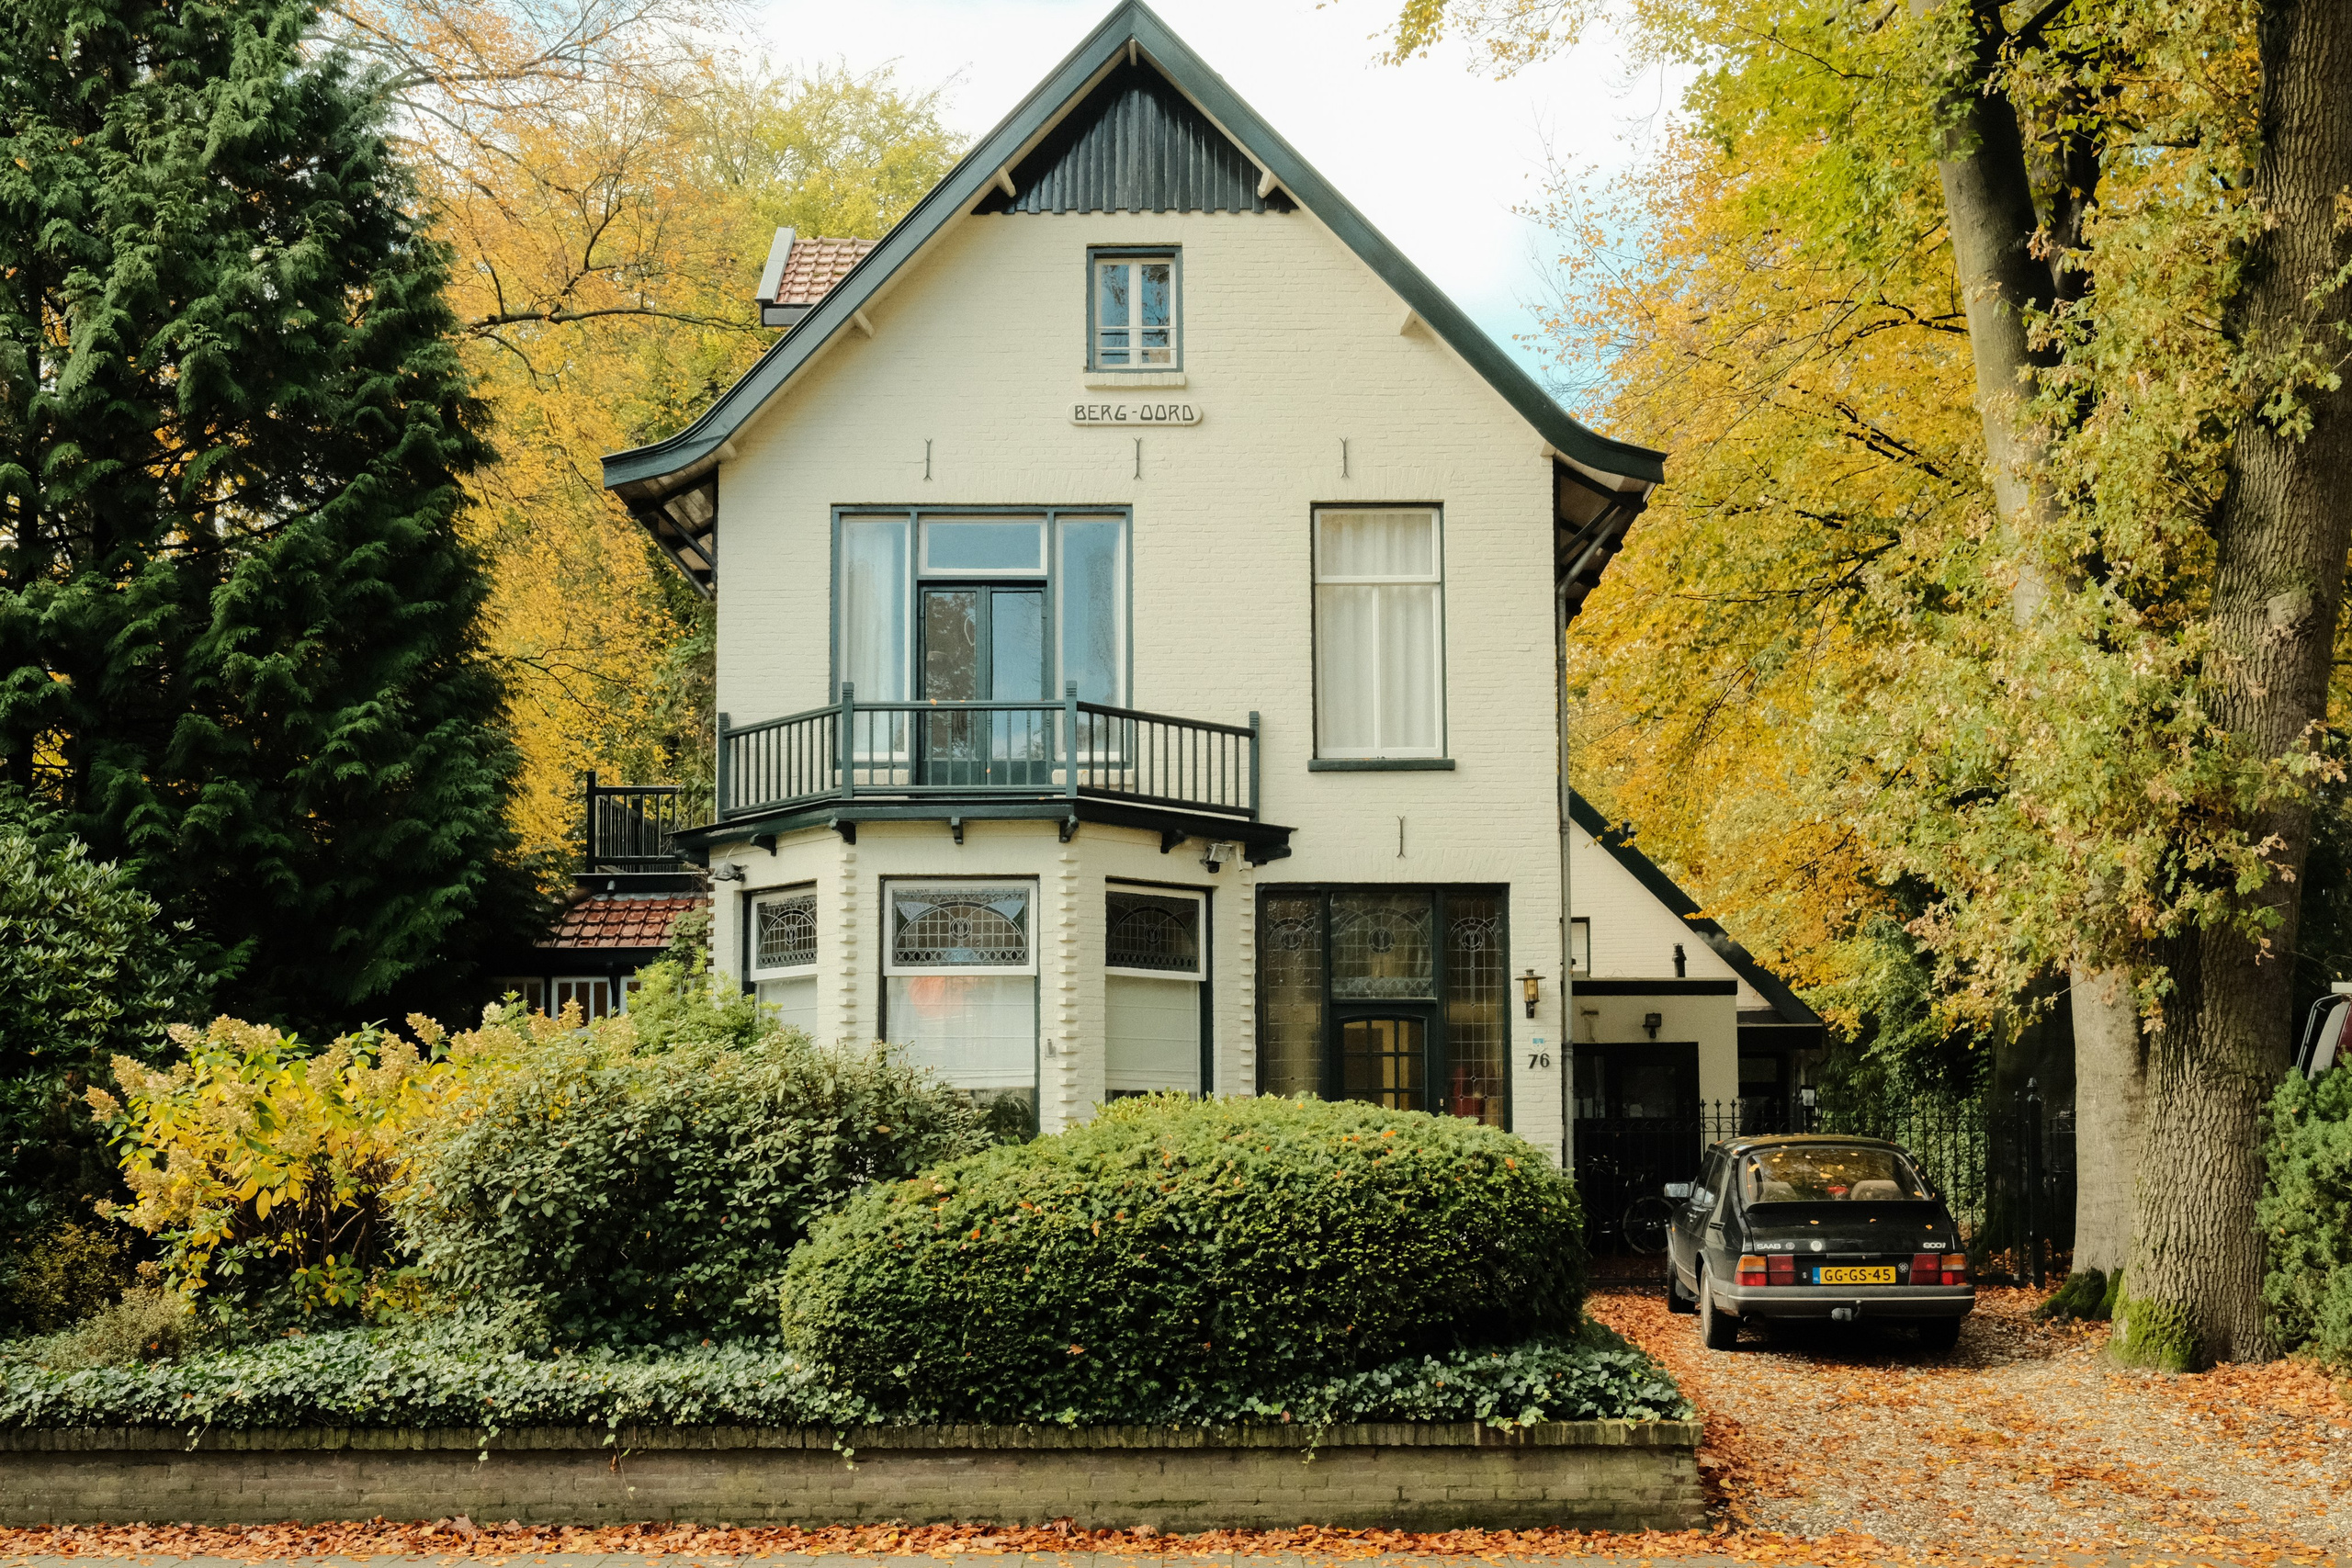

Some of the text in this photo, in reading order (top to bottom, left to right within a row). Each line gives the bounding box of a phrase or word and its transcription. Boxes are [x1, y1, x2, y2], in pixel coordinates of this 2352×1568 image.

[1075, 404, 1194, 421] BERG-OORD
[1528, 1053, 1550, 1069] 76
[1824, 1269, 1891, 1281] GG-GS-45
